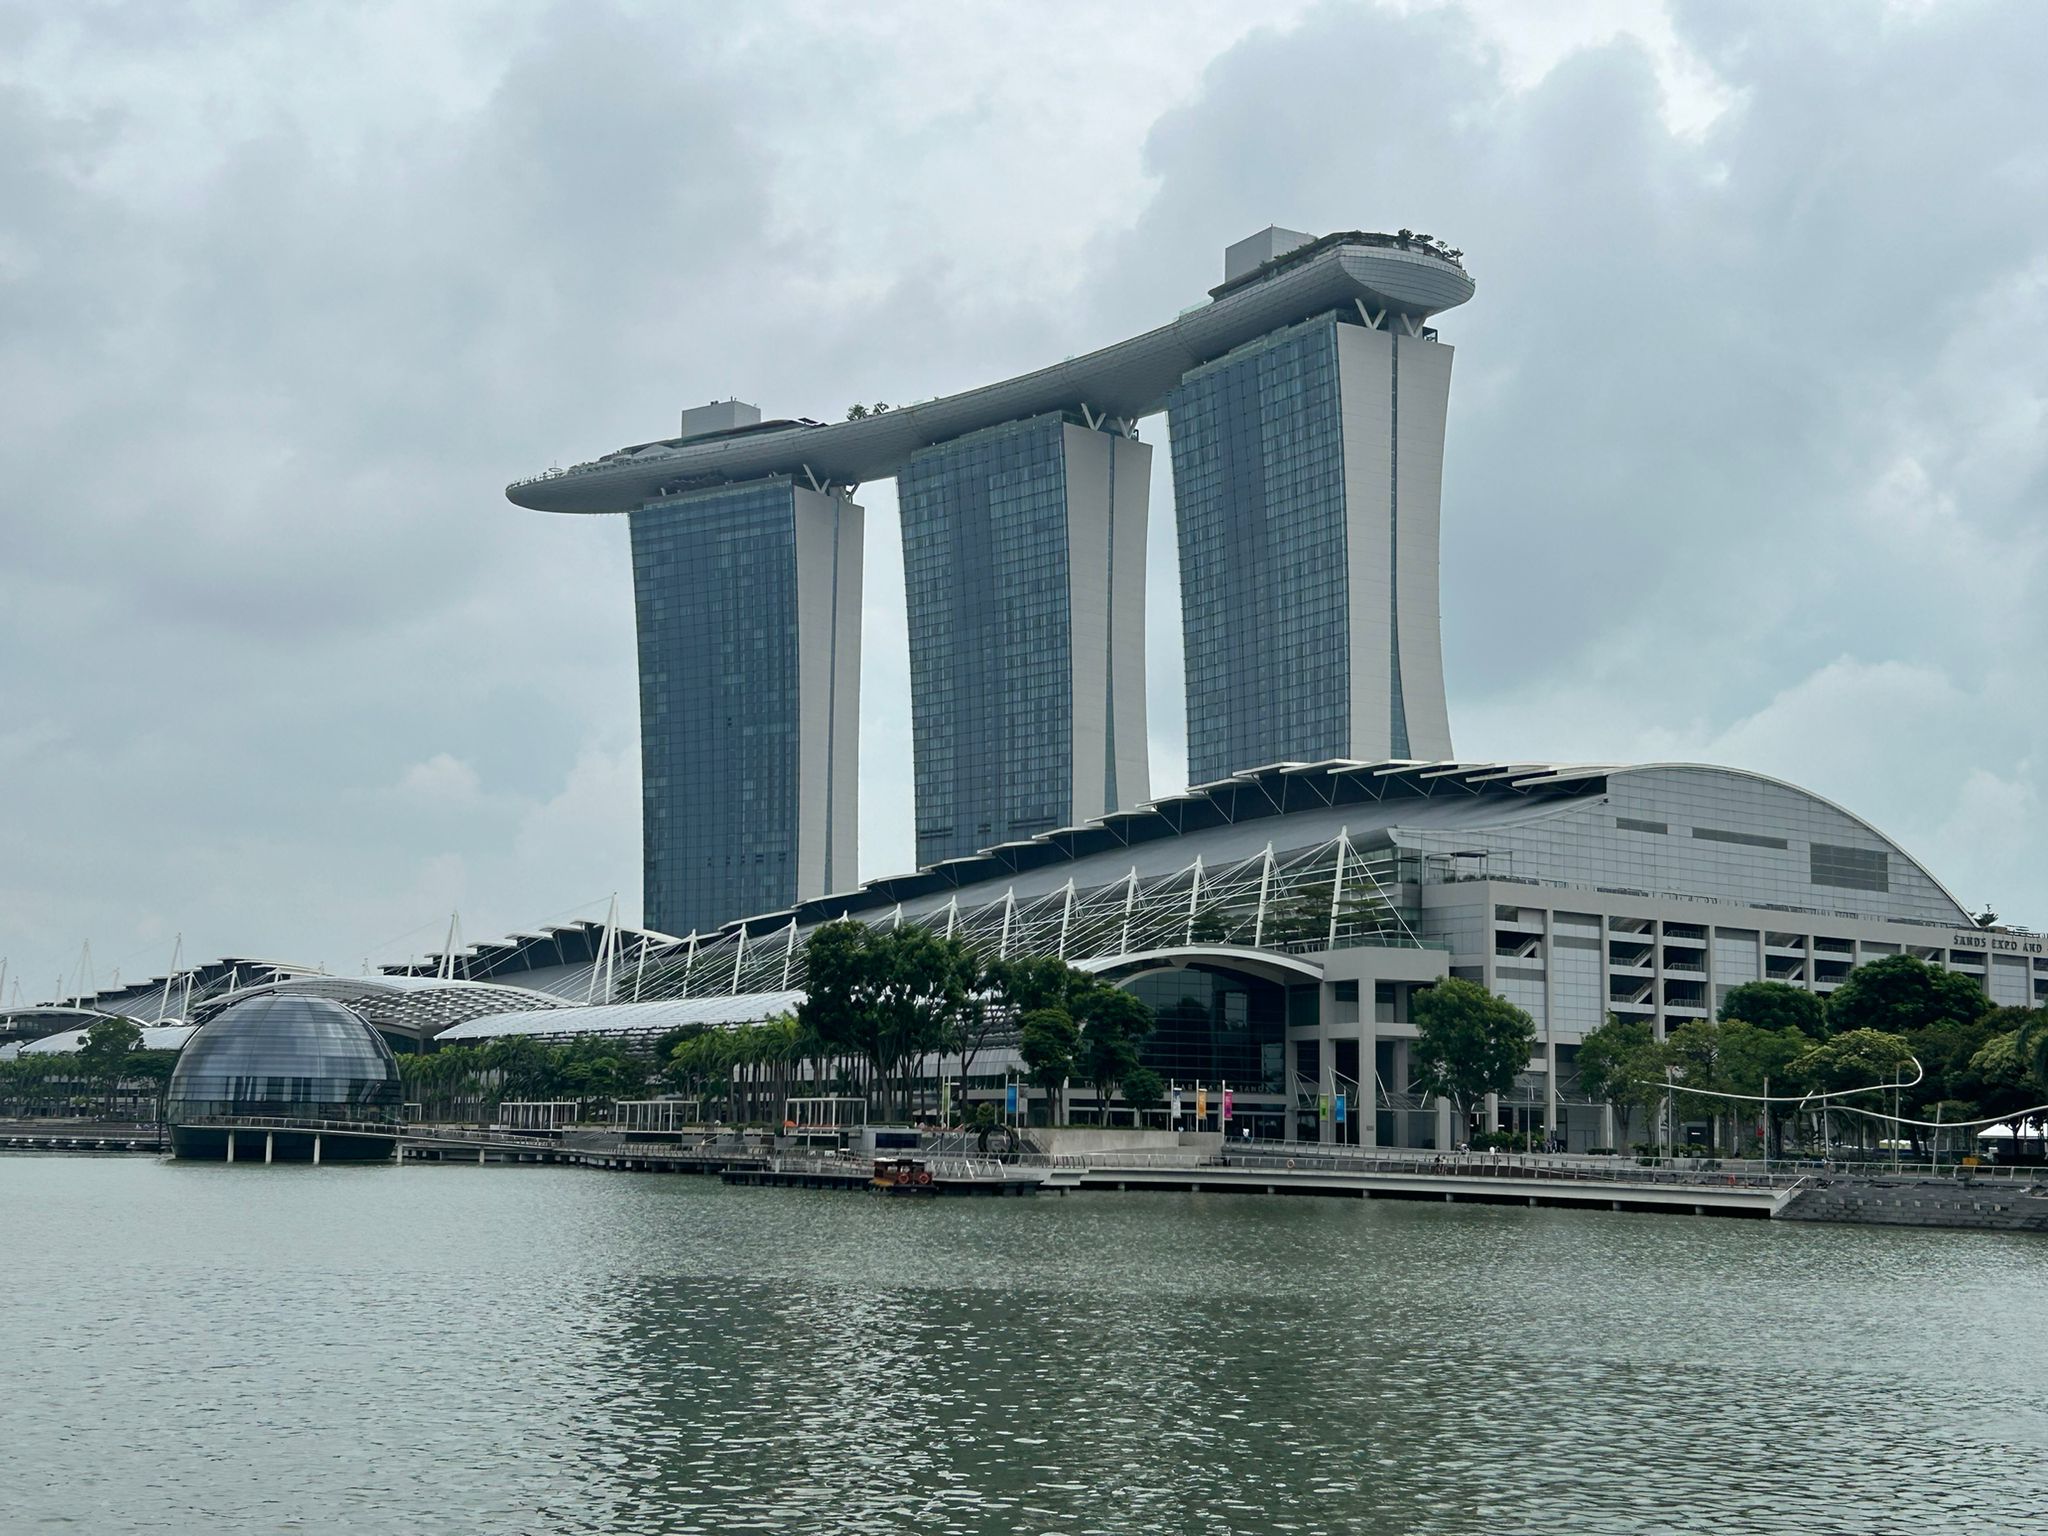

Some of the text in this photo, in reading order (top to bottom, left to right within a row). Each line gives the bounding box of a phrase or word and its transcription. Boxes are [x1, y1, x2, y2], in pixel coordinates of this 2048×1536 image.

[1953, 935, 2042, 953] SANDS EXPO AND
